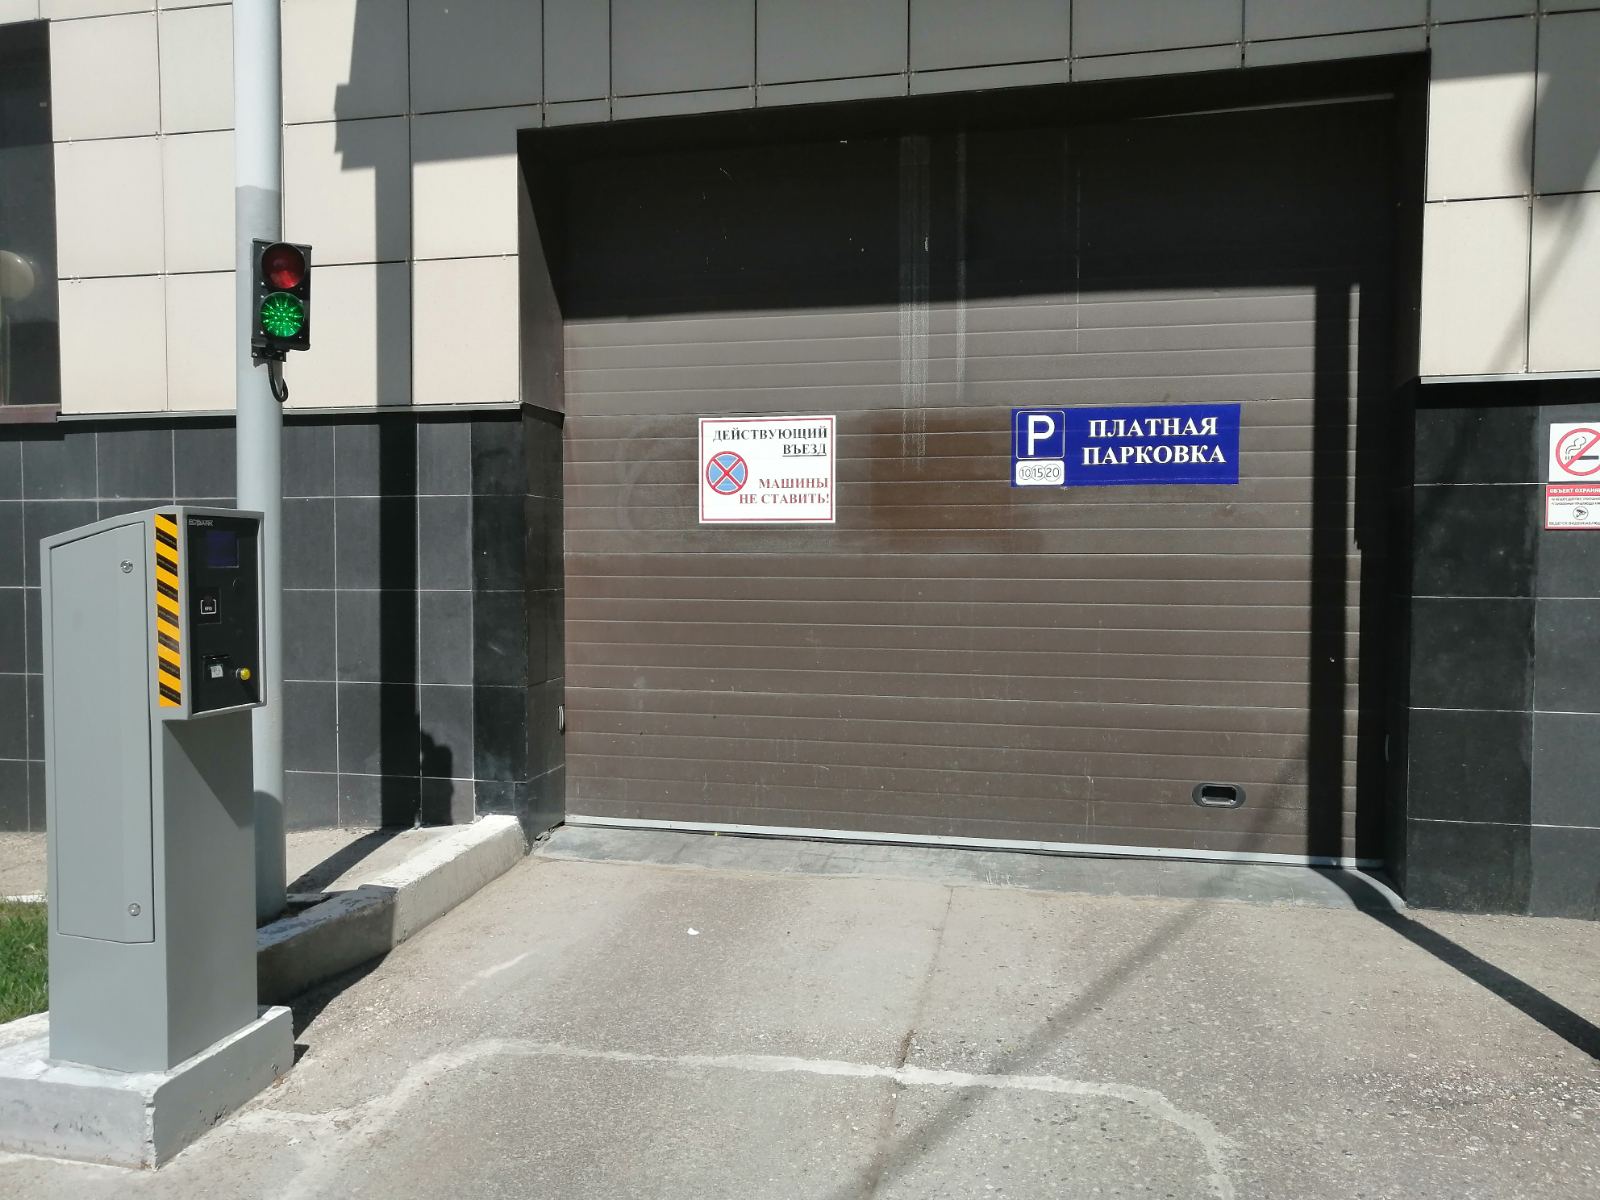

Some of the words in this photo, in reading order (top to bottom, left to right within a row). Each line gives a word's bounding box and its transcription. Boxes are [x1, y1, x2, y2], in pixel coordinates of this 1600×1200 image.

[712, 426, 828, 442] ДЕЙСТВУЮЩИЙ
[1088, 417, 1218, 437] ПЛАТНАЯ
[1028, 415, 1055, 455] P
[783, 443, 827, 455] ВЪЕЗД
[1081, 445, 1227, 465] ПАРКОВКА
[1021, 469, 1031, 478] 10
[1033, 468, 1044, 478] 15
[1045, 467, 1060, 478] 20
[758, 478, 828, 489] МАШИНЫ
[739, 494, 757, 504] НЕ
[761, 493, 829, 504] СТАВИТЬ!
